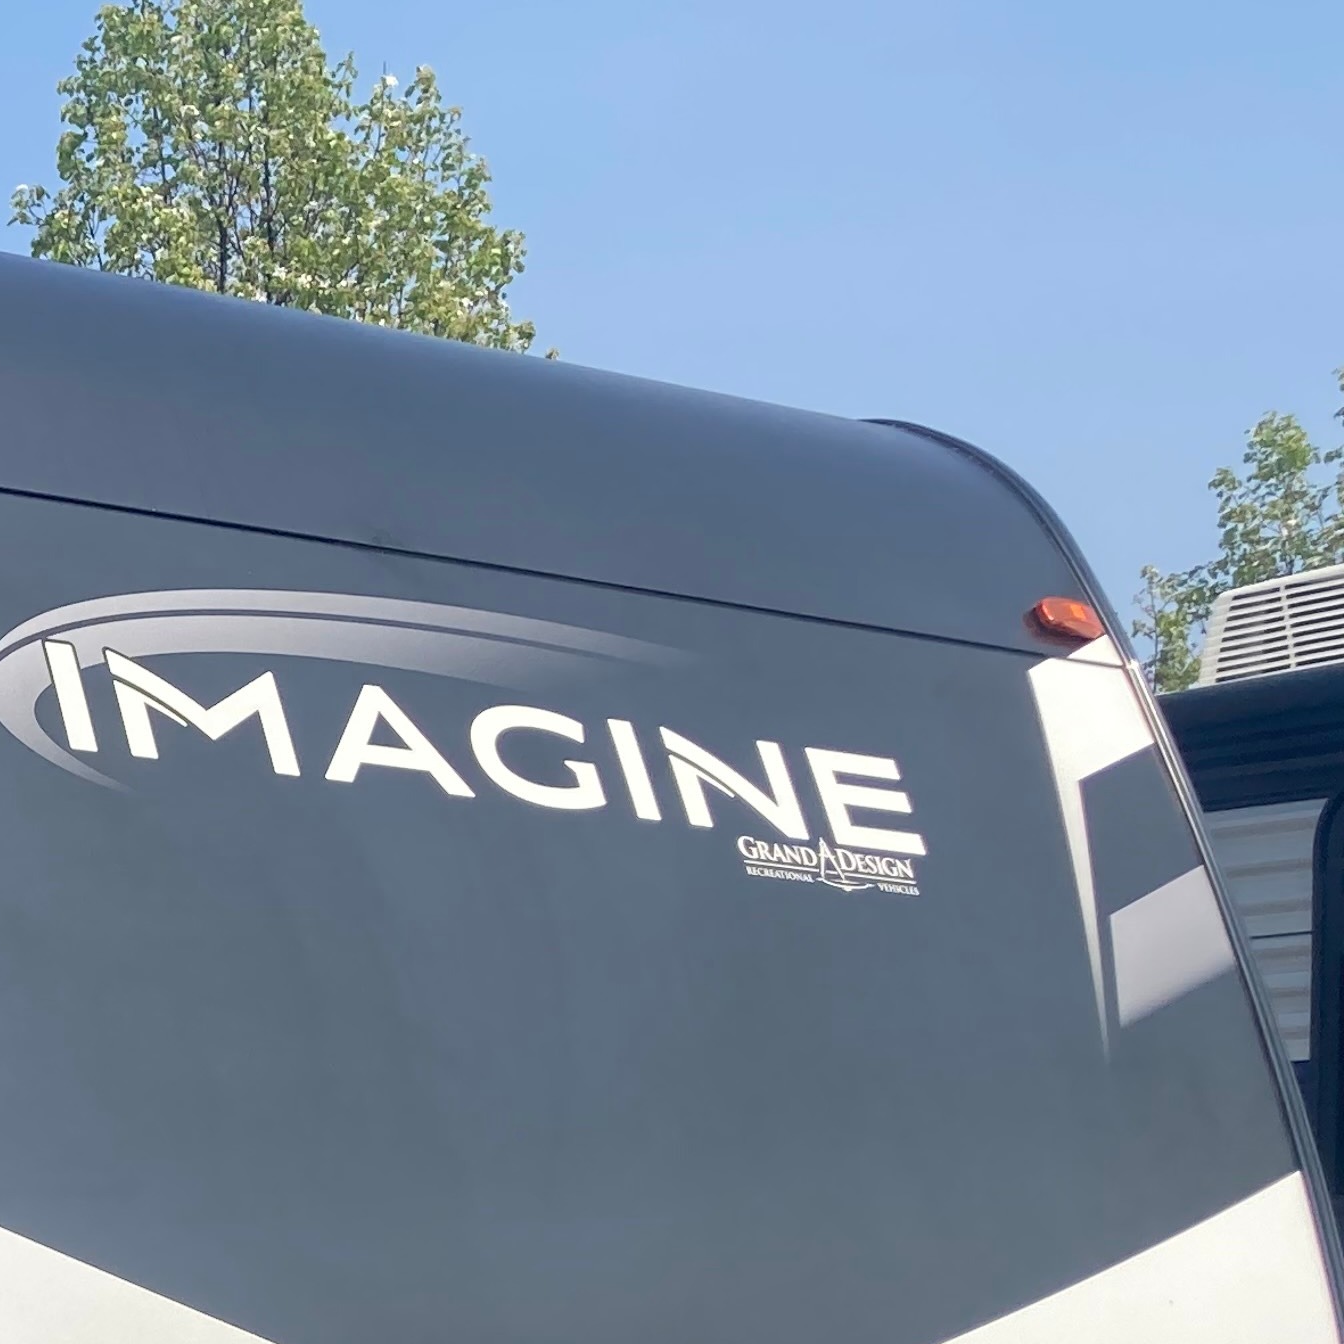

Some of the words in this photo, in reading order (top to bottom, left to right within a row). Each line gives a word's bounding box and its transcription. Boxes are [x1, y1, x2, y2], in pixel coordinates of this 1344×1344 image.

[42, 638, 927, 856] IMAGINE
[737, 836, 817, 867] GRAND
[833, 848, 915, 879] DESIGN
